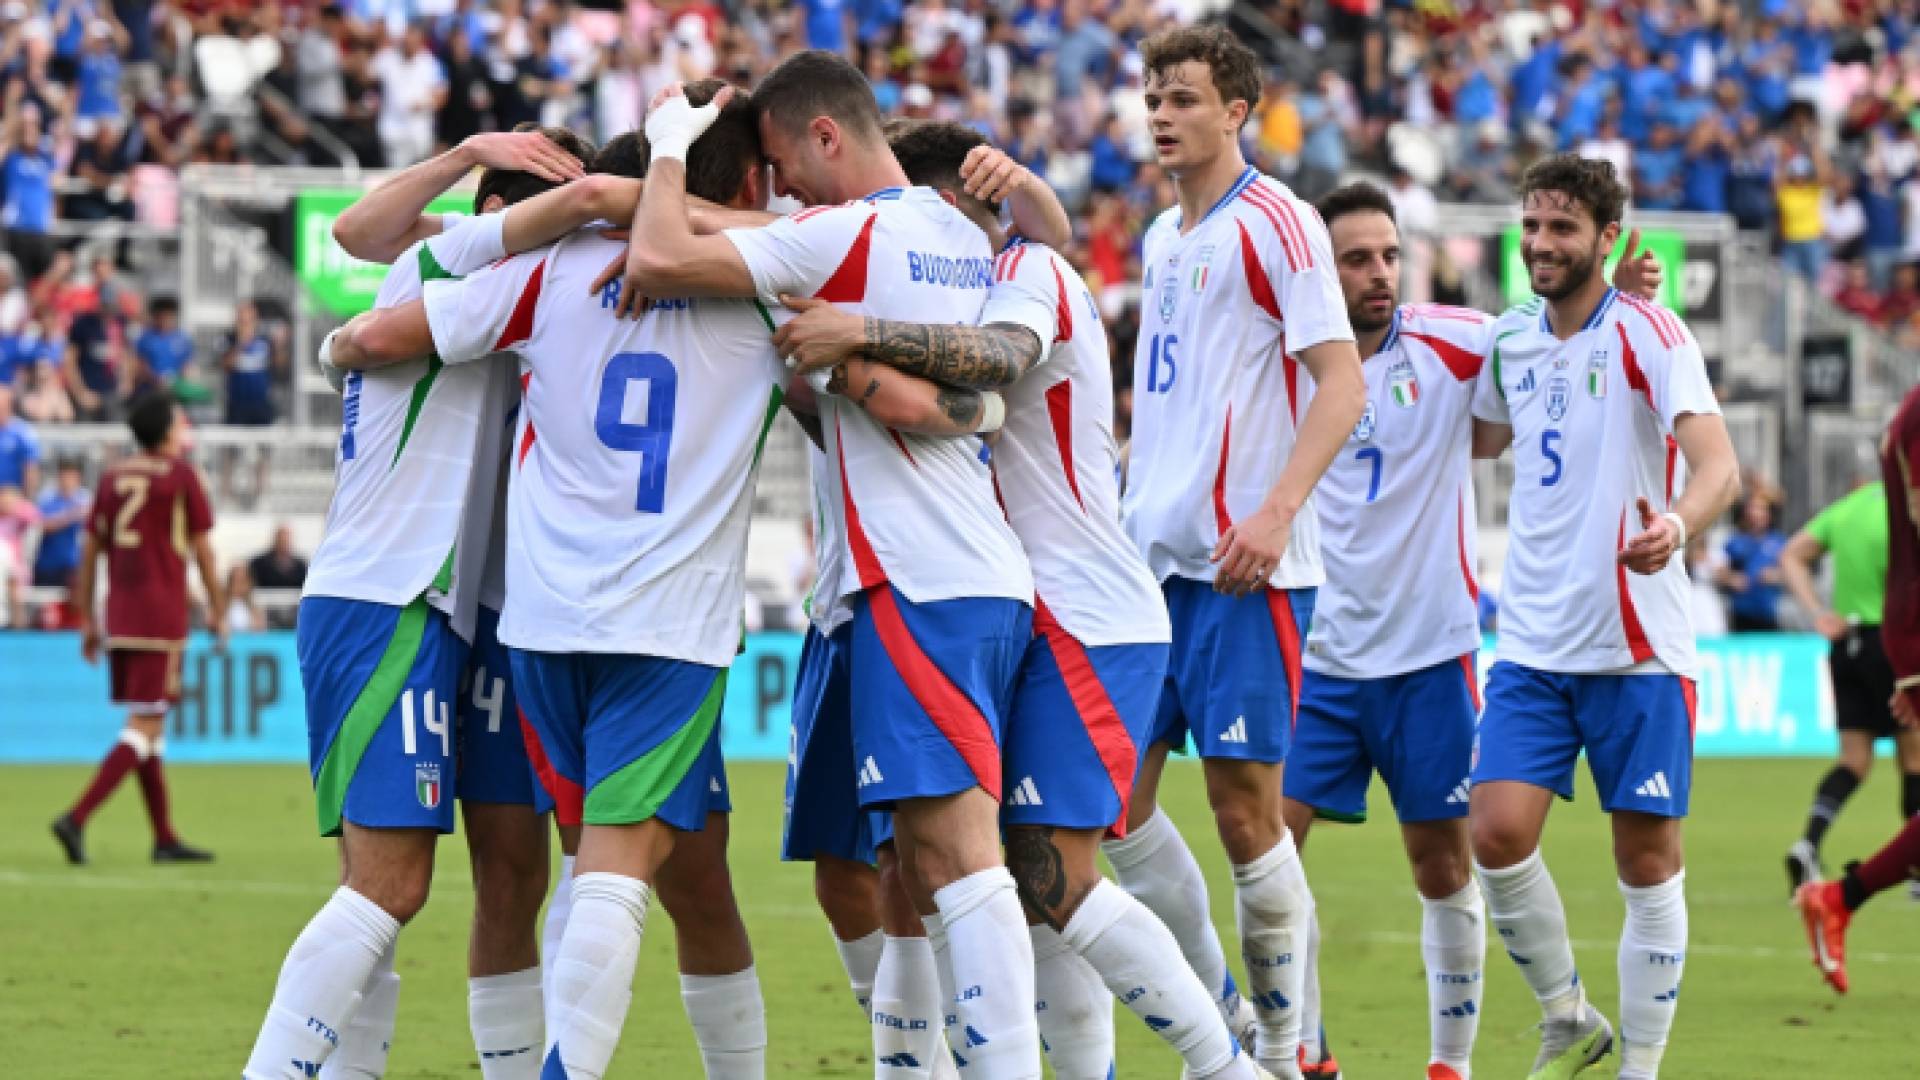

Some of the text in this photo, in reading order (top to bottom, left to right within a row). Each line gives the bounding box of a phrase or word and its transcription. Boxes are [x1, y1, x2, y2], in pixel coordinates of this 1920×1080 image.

[1147, 333, 1178, 394] 15
[595, 352, 676, 514] 9
[1540, 429, 1561, 486] 5
[1355, 447, 1382, 502] 7
[113, 477, 149, 547] 2
[402, 688, 448, 756] 14
[464, 665, 504, 733] 4
